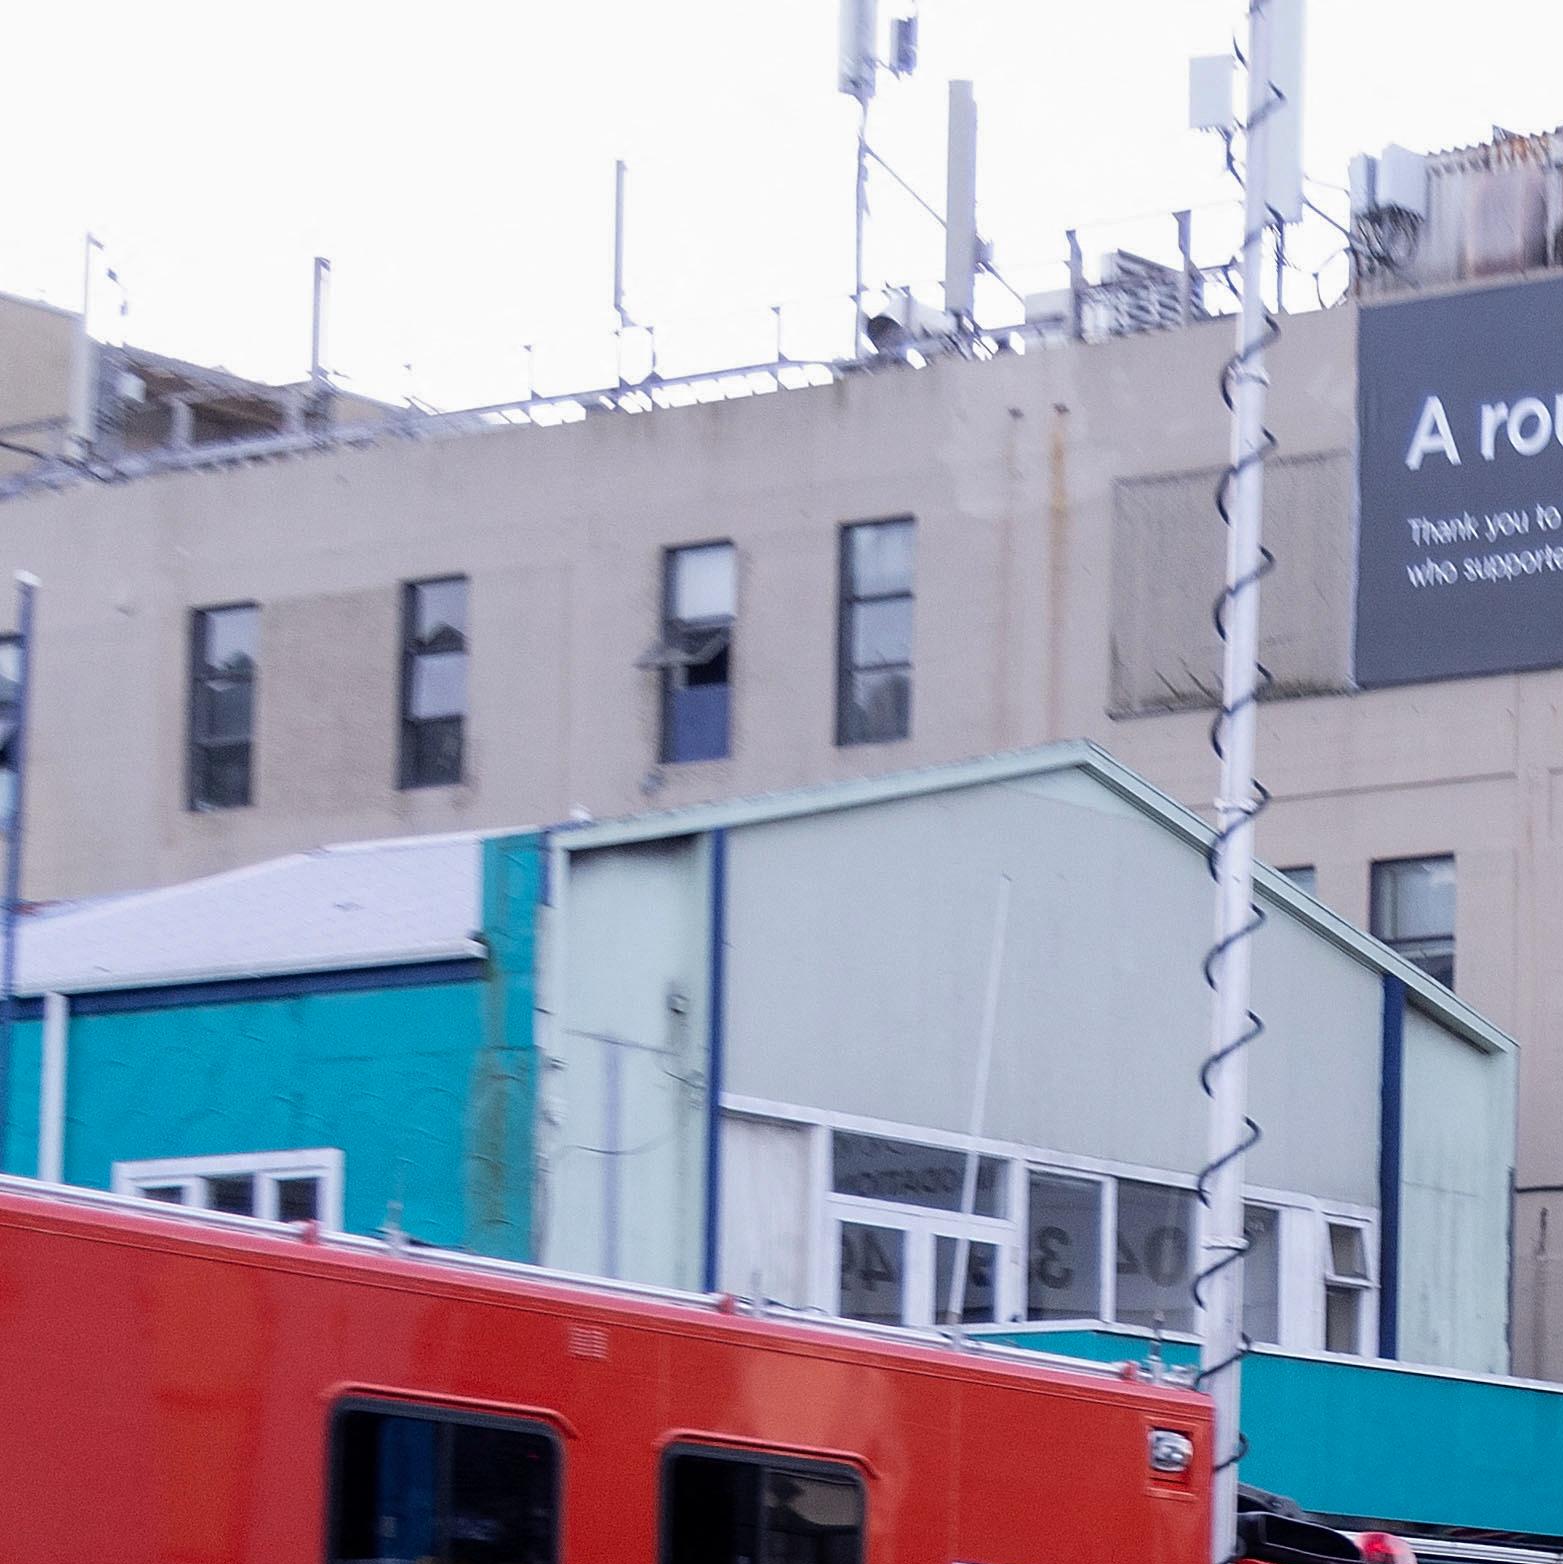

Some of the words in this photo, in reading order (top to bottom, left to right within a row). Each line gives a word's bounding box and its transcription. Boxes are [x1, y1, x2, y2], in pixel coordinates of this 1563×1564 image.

[1405, 396, 1461, 470] A
[1408, 513, 1479, 547] Thank
[1484, 508, 1530, 543] you
[1536, 502, 1562, 531] to
[1407, 554, 1458, 588] who
